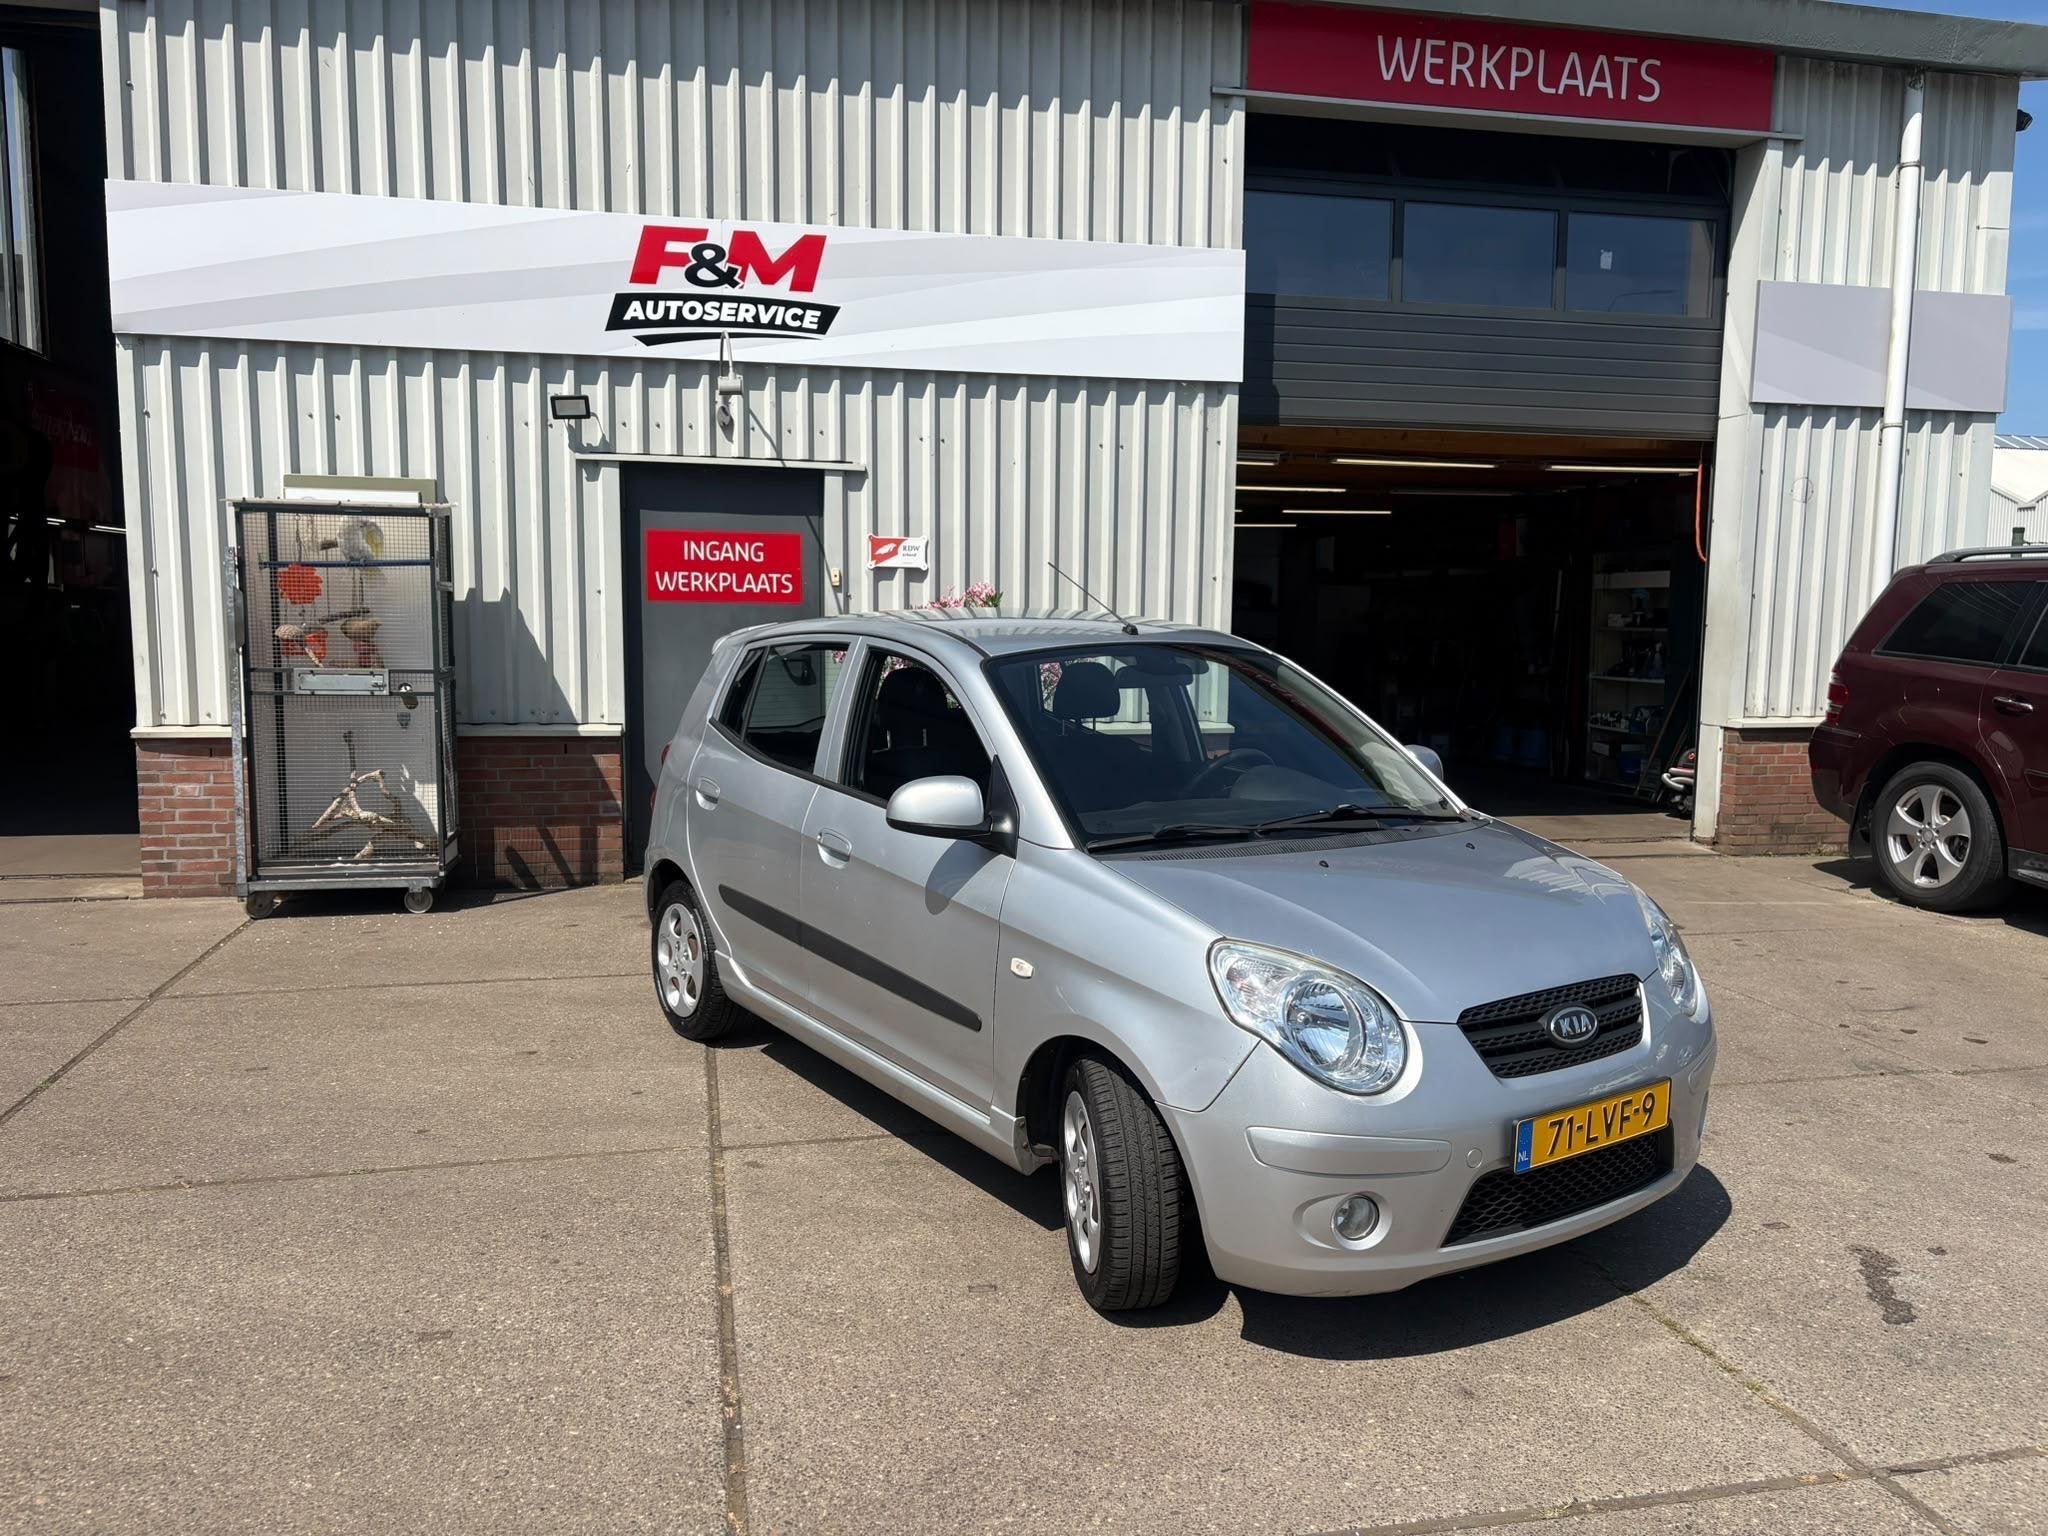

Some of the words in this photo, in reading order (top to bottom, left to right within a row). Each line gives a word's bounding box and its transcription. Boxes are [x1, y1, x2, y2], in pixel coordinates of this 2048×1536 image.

[1377, 35, 1661, 102] WERKPLAATS
[630, 225, 827, 292] F&M
[623, 300, 822, 330] AUTOSERVICE
[684, 540, 764, 562] INGANG
[655, 571, 793, 593] WERKPLAATS
[1558, 1014, 1592, 1037] KIA
[1547, 1091, 1656, 1156] 71-LVF-9
[1518, 1151, 1529, 1163] NL
